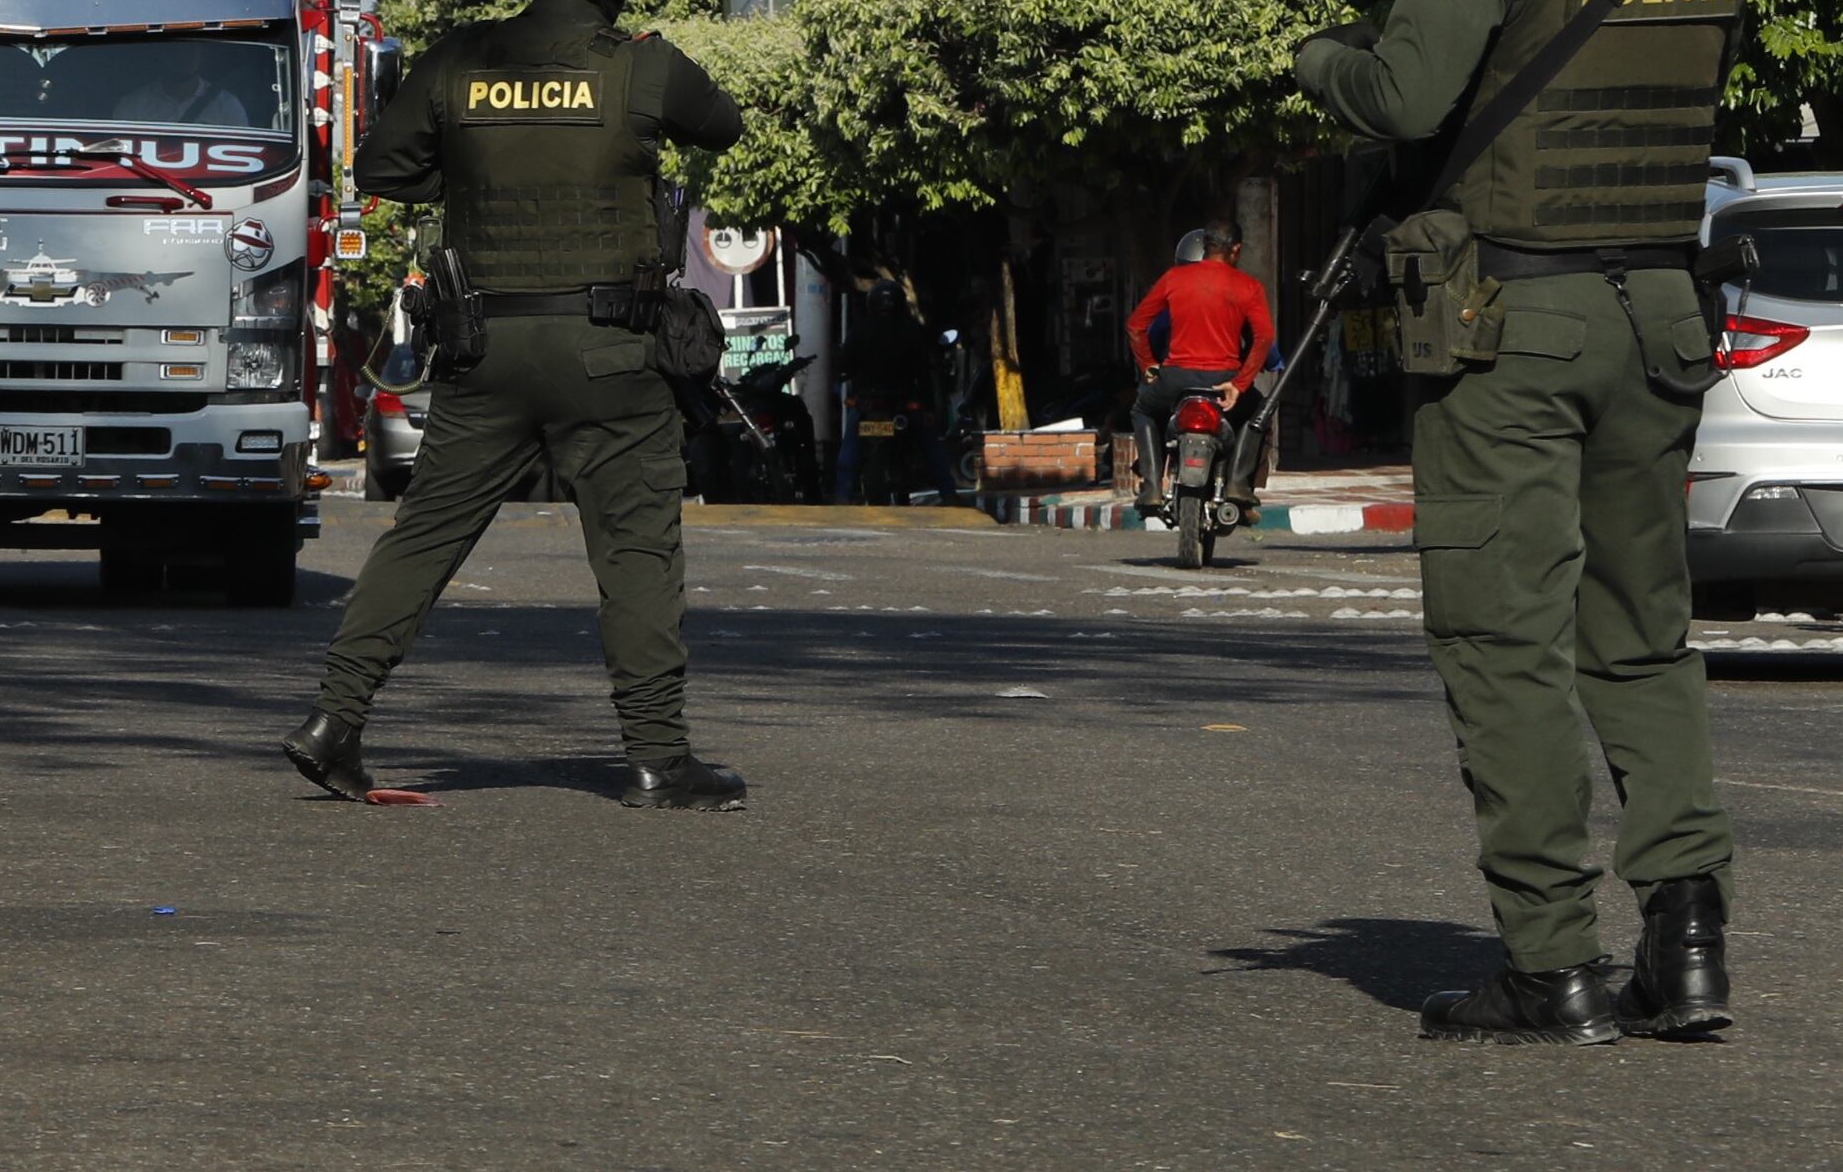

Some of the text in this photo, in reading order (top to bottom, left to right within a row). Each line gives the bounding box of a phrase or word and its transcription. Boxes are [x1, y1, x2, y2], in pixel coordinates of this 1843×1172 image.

[468, 81, 595, 110] POLICIA
[724, 334, 787, 351] MINTOS
[1413, 342, 1432, 358] US
[1762, 368, 1803, 379] JAC
